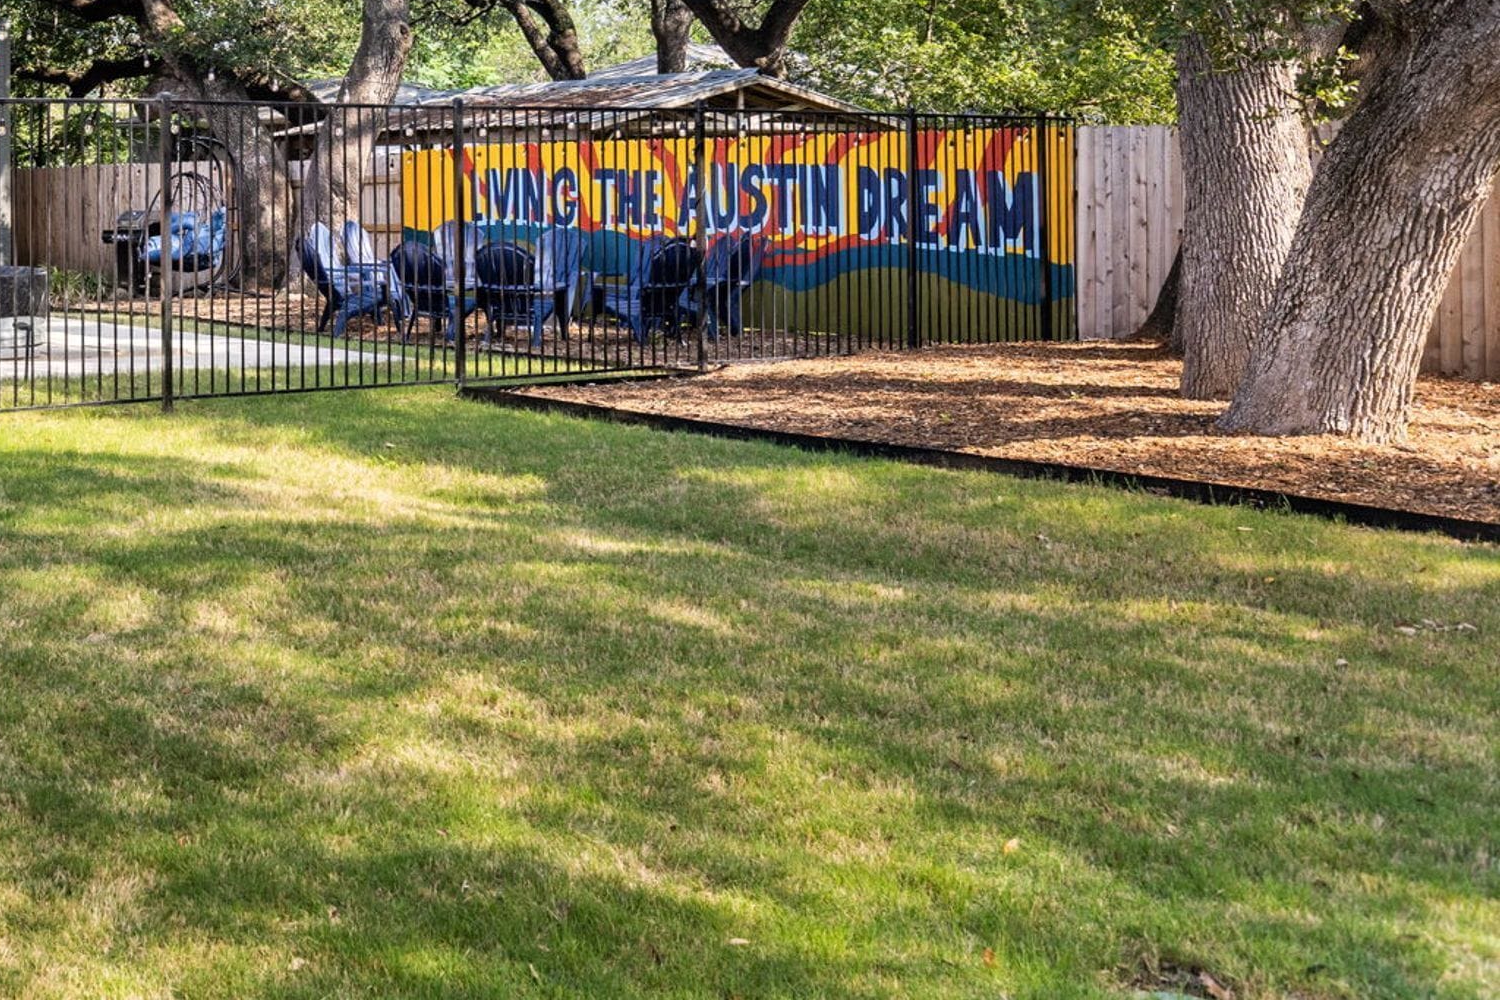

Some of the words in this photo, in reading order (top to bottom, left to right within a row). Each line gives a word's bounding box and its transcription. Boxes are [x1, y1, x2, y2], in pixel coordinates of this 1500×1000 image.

[594, 167, 661, 230] THE
[677, 162, 844, 235] AUSTIN
[859, 165, 1040, 259] DREAM
